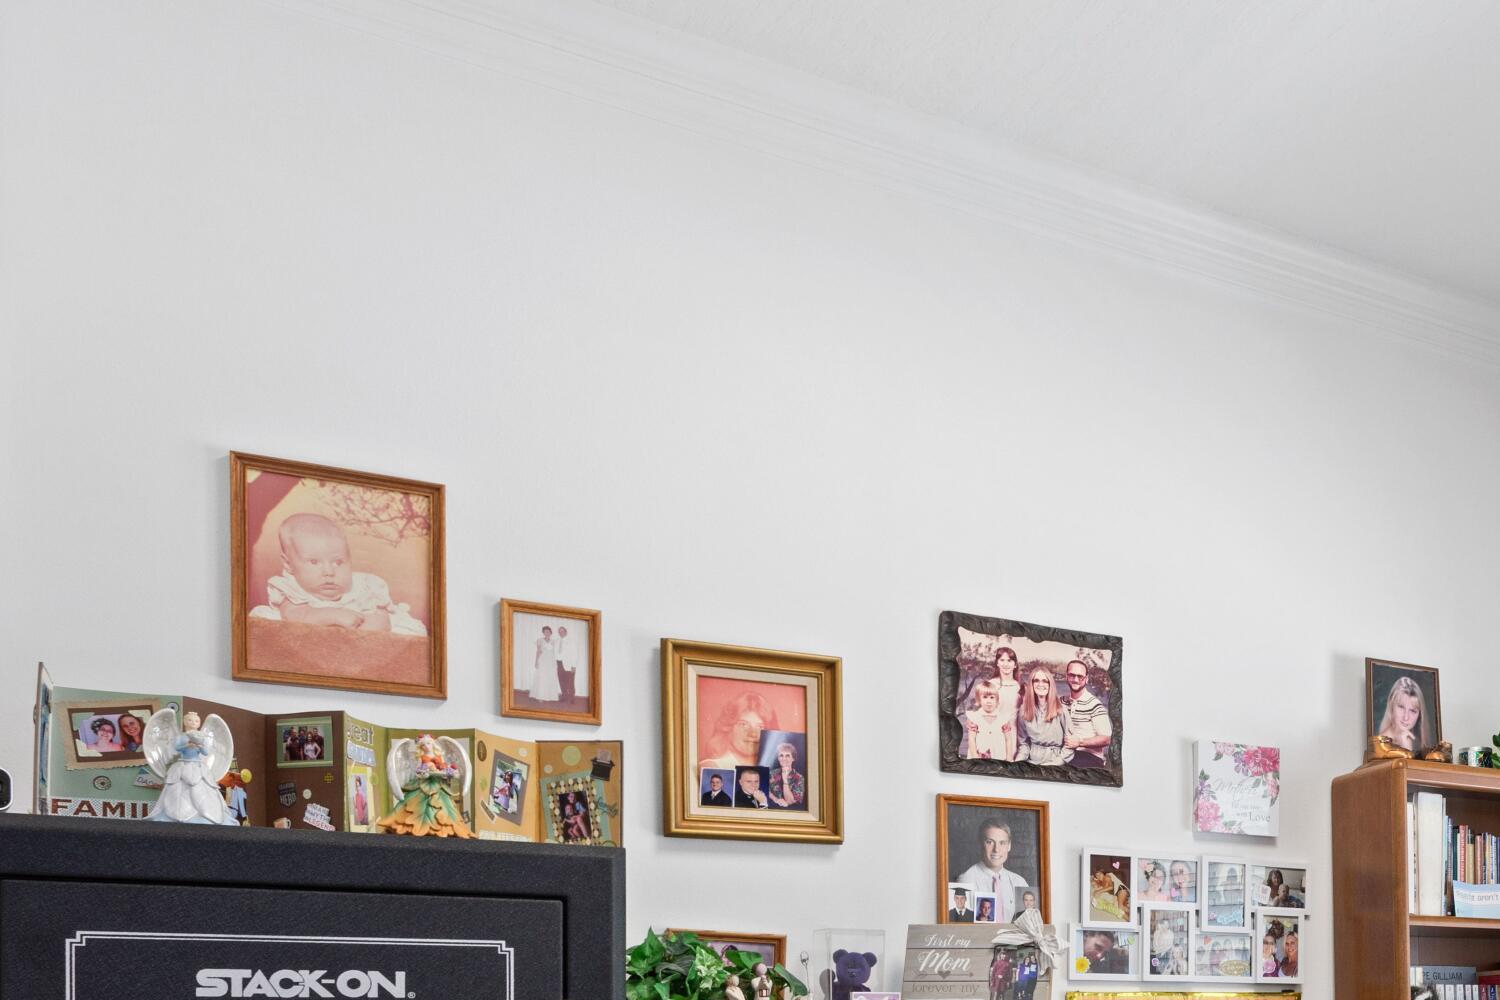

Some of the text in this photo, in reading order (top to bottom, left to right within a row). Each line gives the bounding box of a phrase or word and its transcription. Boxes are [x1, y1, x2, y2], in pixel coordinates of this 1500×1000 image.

[1250, 812, 1271, 823] Love
[918, 949, 971, 974] Mom
[196, 968, 406, 998] STACK-ON
